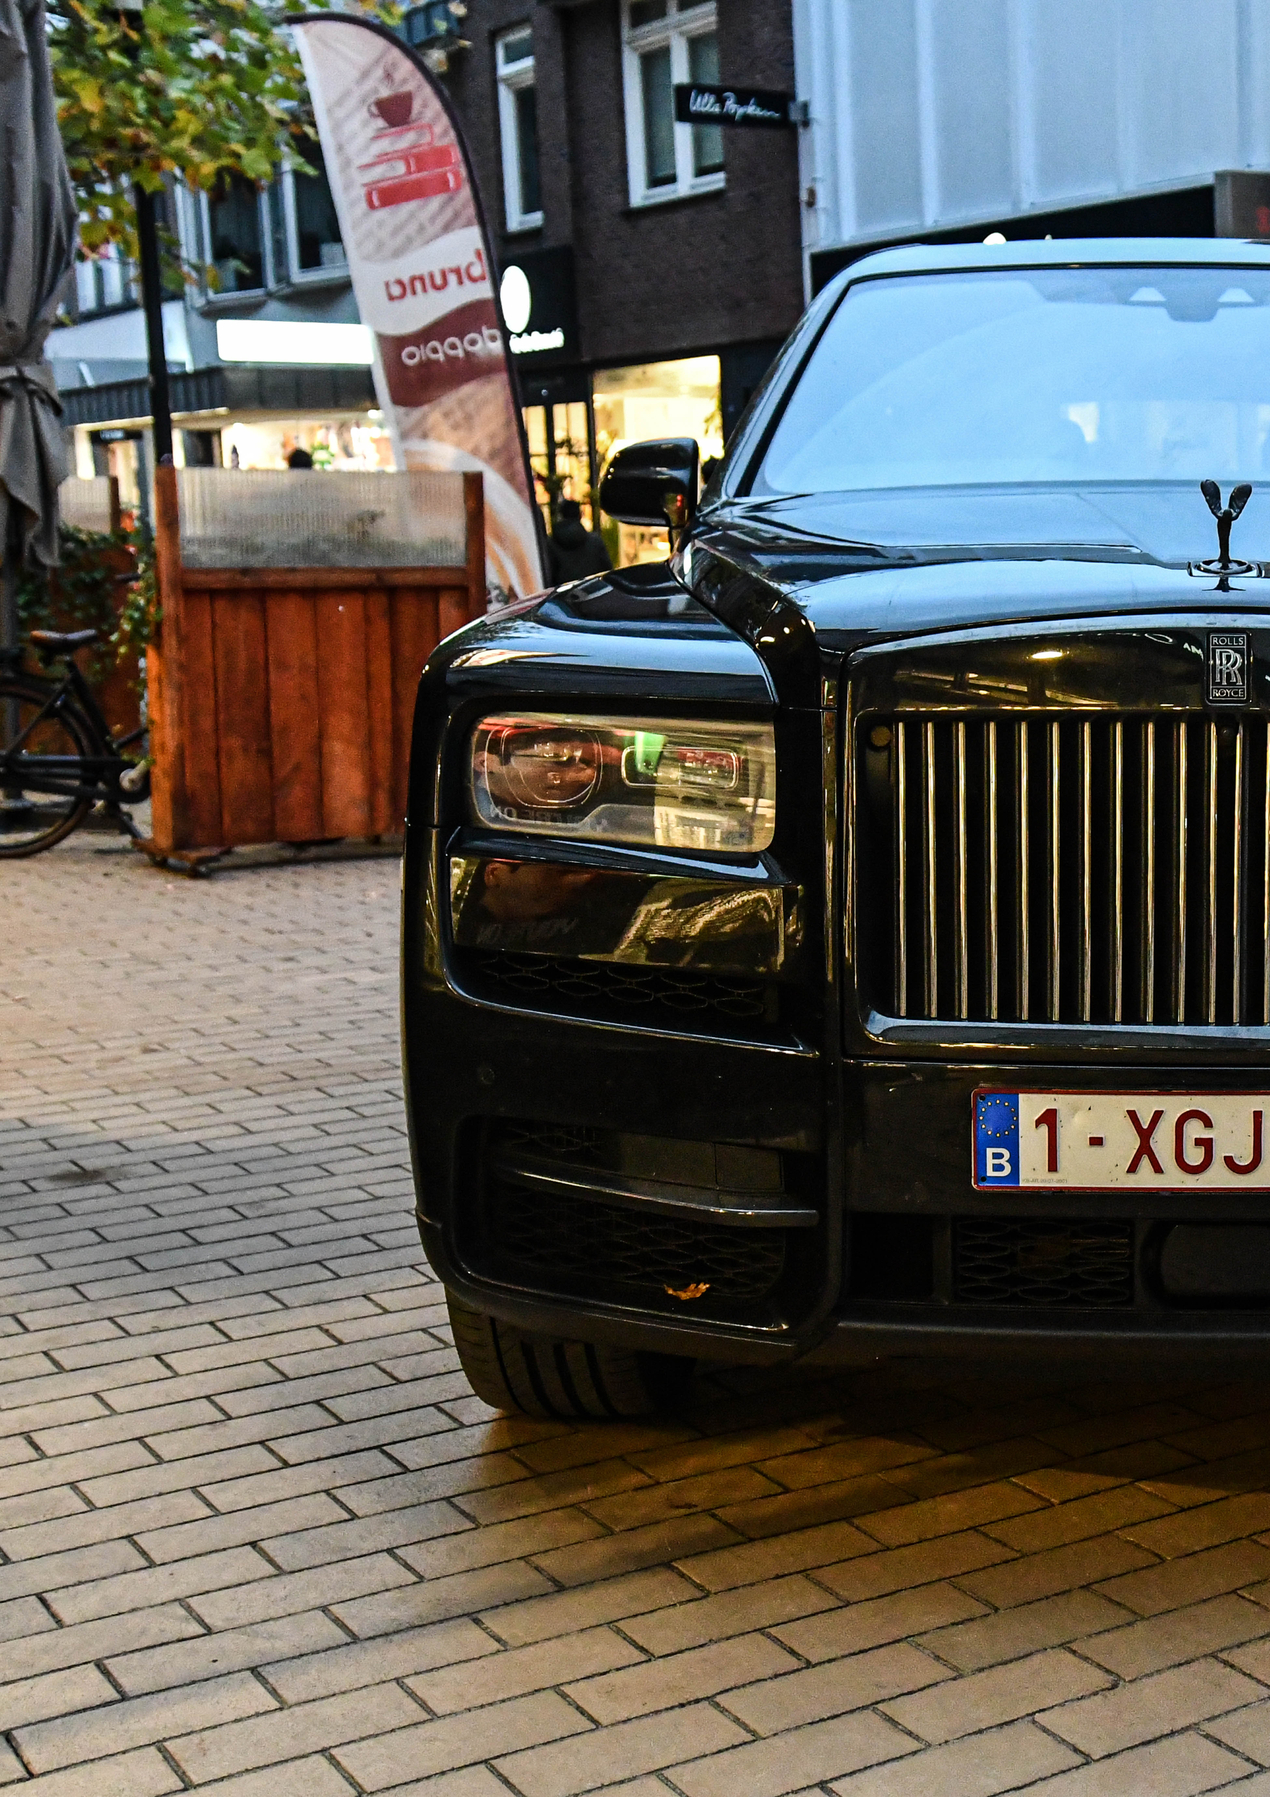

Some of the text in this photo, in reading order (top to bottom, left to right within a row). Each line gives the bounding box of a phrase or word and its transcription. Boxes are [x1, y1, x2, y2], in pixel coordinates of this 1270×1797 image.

[690, 89, 721, 113] Ulla
[1212, 637, 1244, 646] ROLLS
[1212, 688, 1244, 697] ROYCE
[985, 1147, 1012, 1177] B
